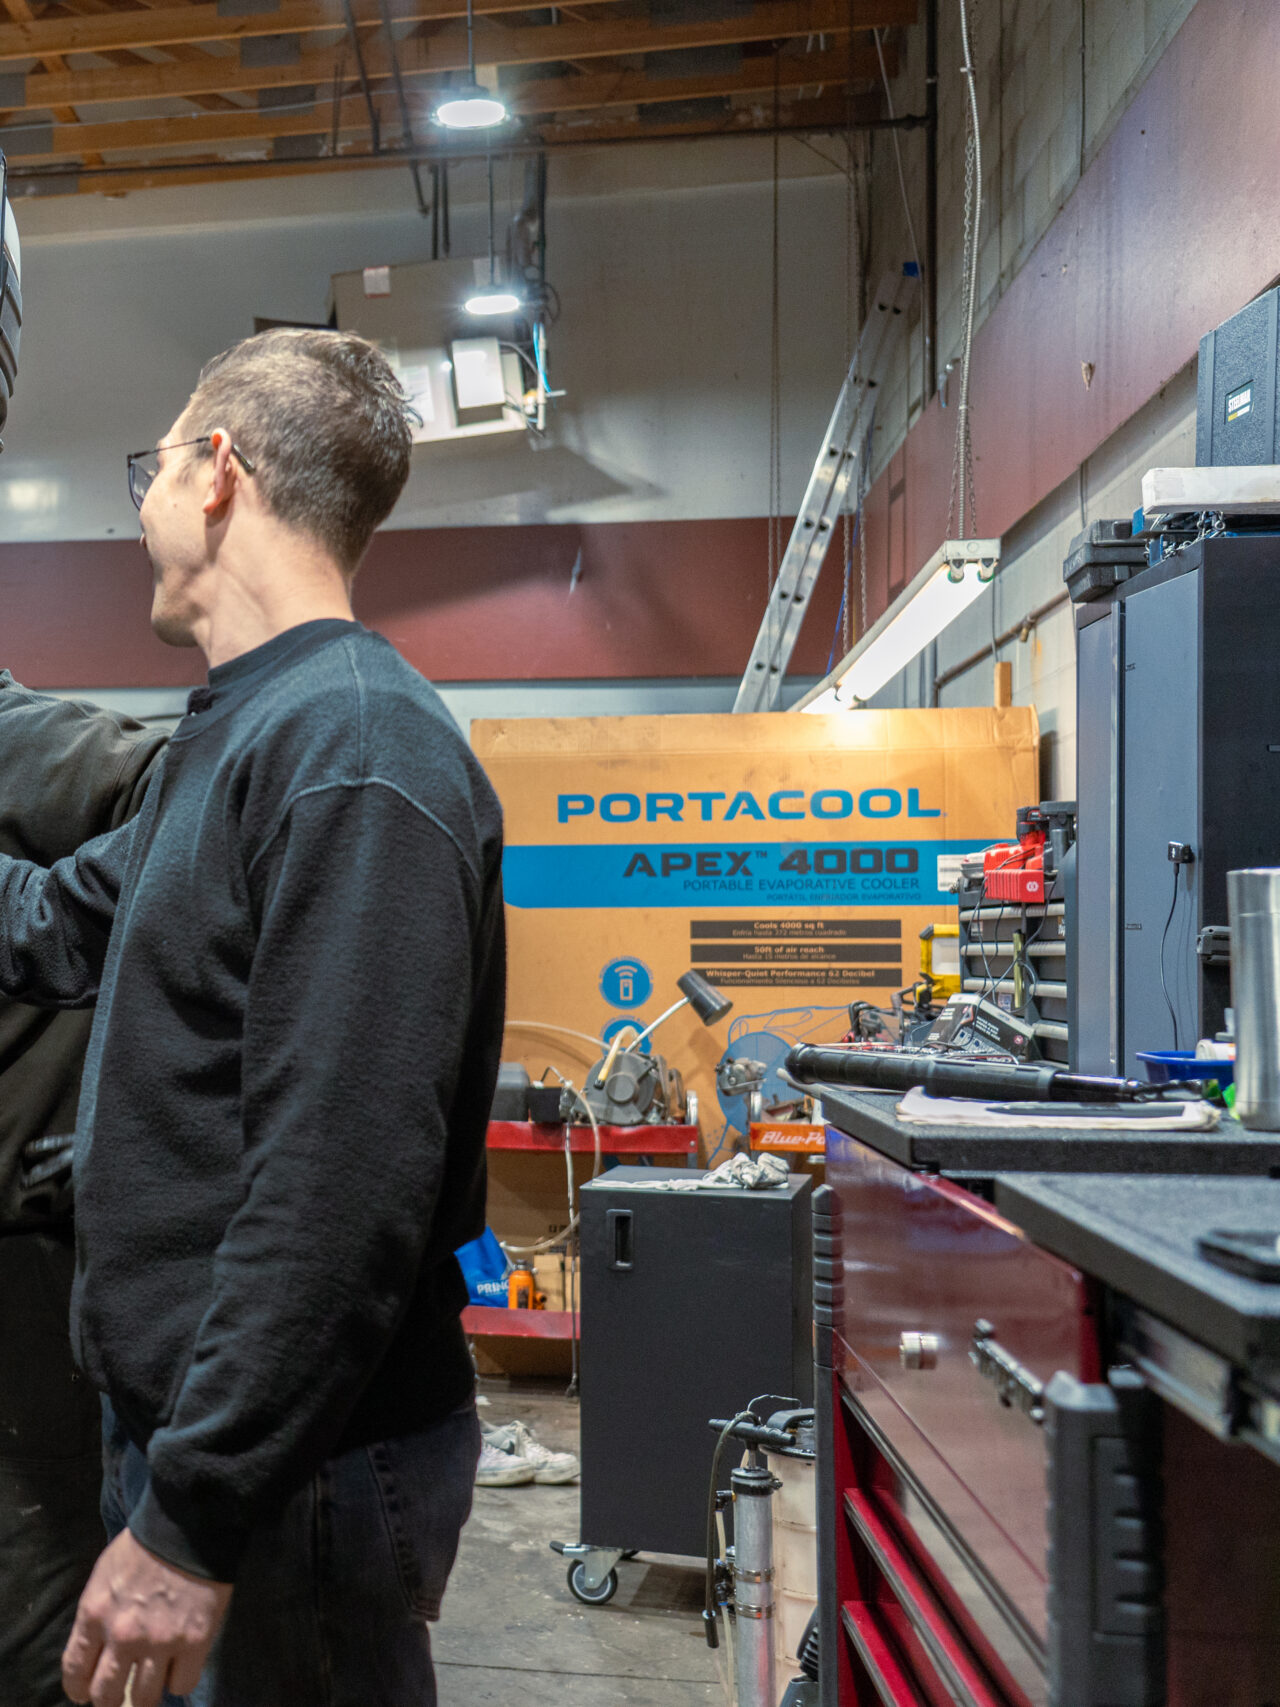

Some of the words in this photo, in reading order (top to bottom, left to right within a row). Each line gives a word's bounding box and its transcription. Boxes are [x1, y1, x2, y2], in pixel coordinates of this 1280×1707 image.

[557, 788, 942, 823] PORTACOOL
[779, 847, 919, 875] 4000
[683, 879, 753, 891] PORTABLE
[759, 877, 856, 890] EVAPORATIVE
[861, 876, 919, 890] COOLER
[754, 921, 778, 929] Cools
[780, 921, 802, 929] 4000
[804, 923, 815, 931] sq
[754, 945, 772, 953] 50ft
[774, 945, 784, 953] of
[786, 945, 798, 953] air
[800, 945, 824, 953] reach
[770, 969, 825, 978] Performance
[828, 969, 840, 977] 62
[842, 969, 875, 977] Decibel
